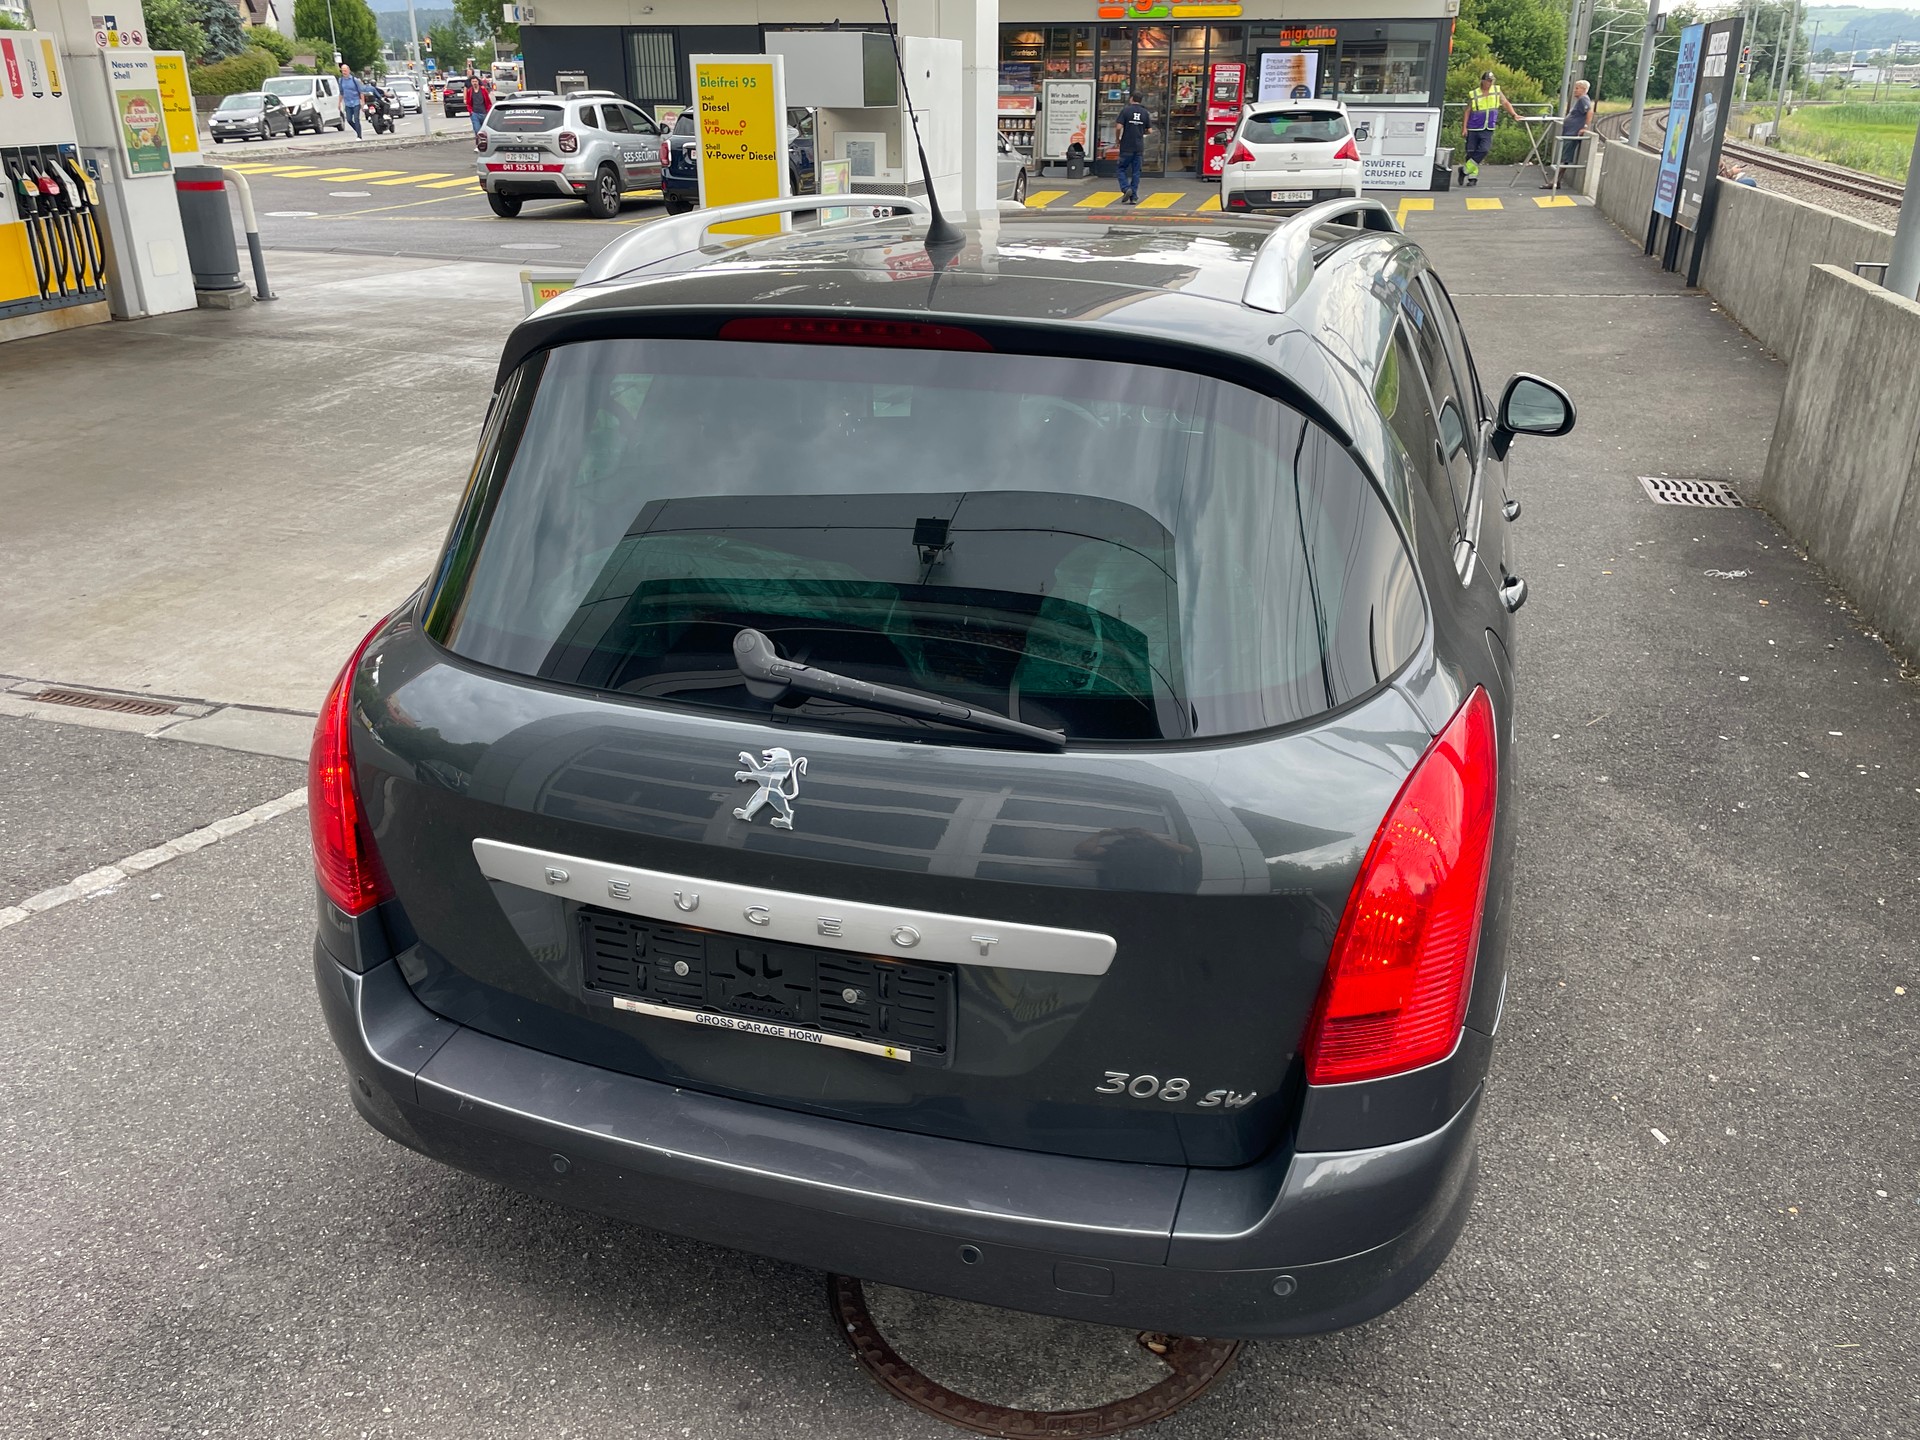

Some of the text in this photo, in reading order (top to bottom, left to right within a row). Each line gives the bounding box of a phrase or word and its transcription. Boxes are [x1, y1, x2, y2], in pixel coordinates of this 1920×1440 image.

[1280, 25, 1338, 42] migrolino
[111, 61, 133, 69] Neues
[114, 71, 131, 79] Shell
[700, 77, 757, 88] Bleifrei 95
[702, 102, 730, 112] Diesel
[125, 114, 159, 124] Glücksrad
[1133, 112, 1141, 120] H
[705, 126, 744, 136] V-Power
[623, 150, 660, 163] SES-SECURITY
[706, 151, 776, 160] V-Power Diesel
[1362, 159, 1406, 168] ISWÜRFEL
[1364, 169, 1423, 178] CRUSHED ICE
[544, 866, 999, 956] PEUGEOT
[695, 1013, 823, 1043] GROSS GARAGE HORW
[1094, 1070, 1257, 1109] 308 SW
